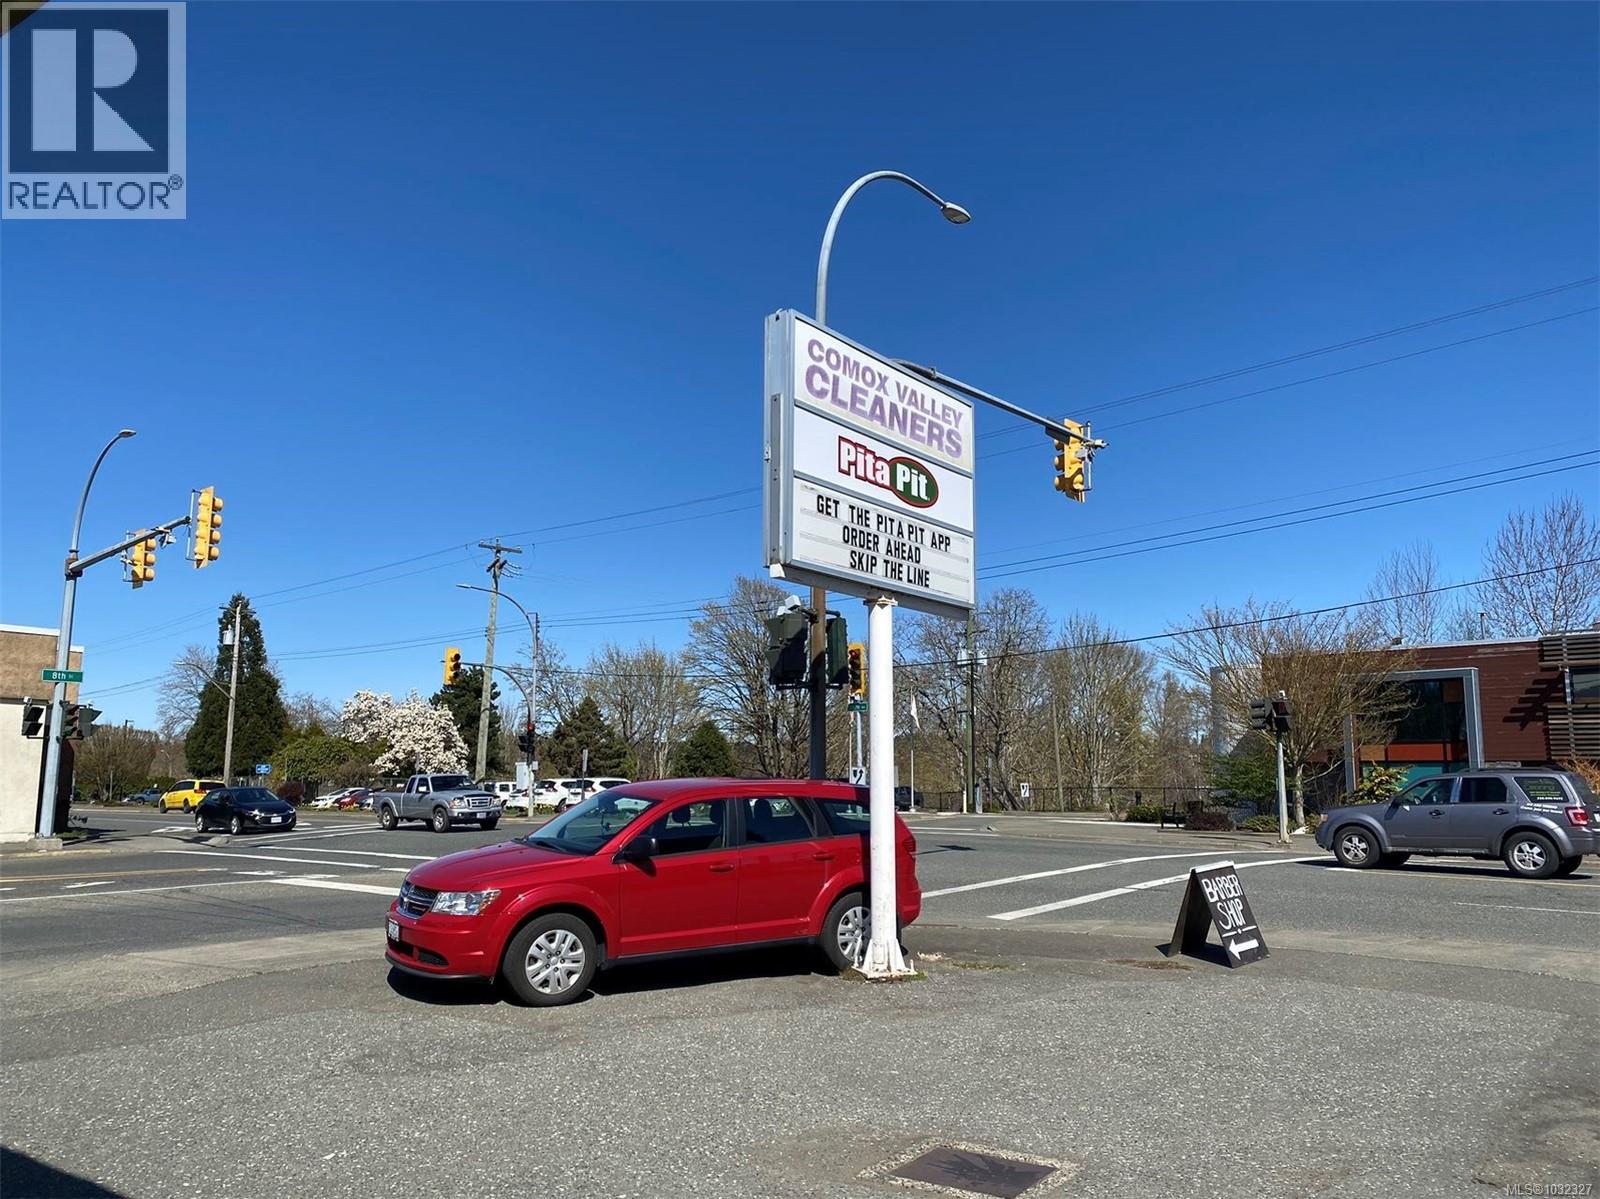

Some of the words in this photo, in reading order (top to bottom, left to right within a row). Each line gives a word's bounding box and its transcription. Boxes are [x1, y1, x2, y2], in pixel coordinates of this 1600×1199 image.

[807, 338, 890, 397] COMOX
[896, 380, 963, 430] VALLEY
[805, 364, 962, 458] CLEANERS
[838, 436, 891, 490] Pita
[896, 462, 929, 501] Pit
[817, 494, 840, 518] GET
[849, 504, 870, 528] THE
[877, 513, 904, 539] PITA
[908, 523, 925, 545] PIT
[931, 531, 951, 552] APP
[842, 525, 879, 553] ORDER
[886, 538, 921, 564] AHEAD
[850, 550, 877, 574] SKIP
[884, 559, 903, 581] THE
[907, 566, 930, 588] LINE
[52, 671, 67, 680] 8th
[1201, 874, 1243, 903] BARBER
